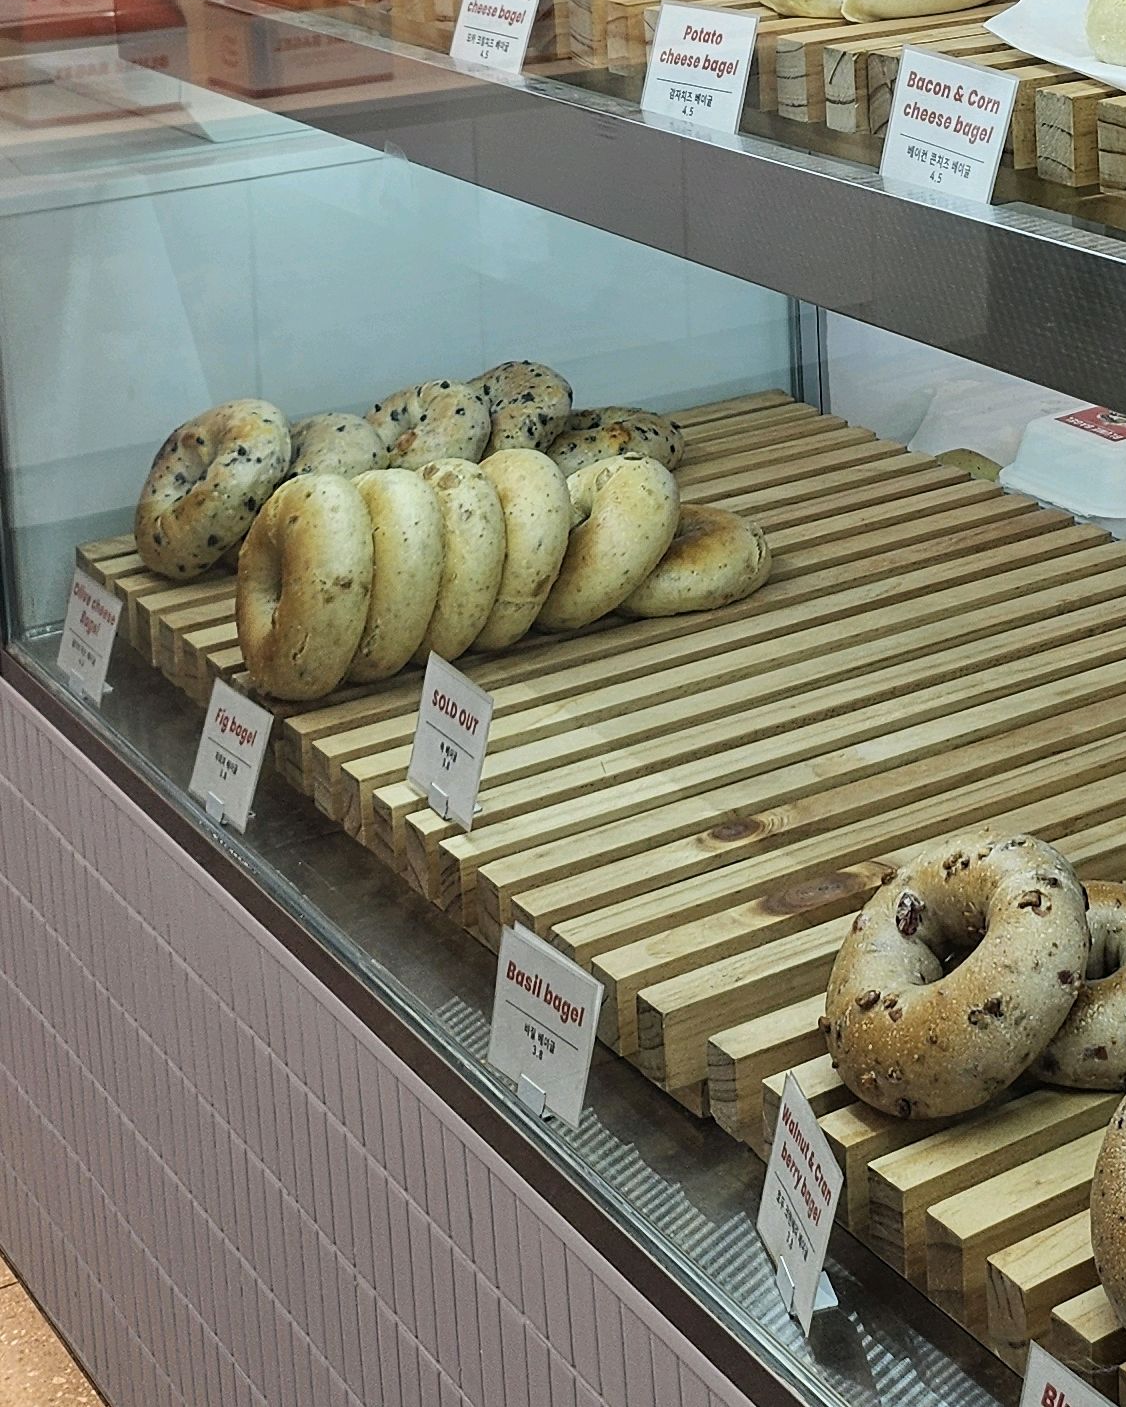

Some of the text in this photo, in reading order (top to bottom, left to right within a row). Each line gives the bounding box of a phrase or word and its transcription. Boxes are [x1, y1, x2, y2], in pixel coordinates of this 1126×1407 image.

[467, 0, 527, 26] cheese bagel
[683, 25, 723, 45] Potato
[660, 48, 739, 79] cheese bagel
[669, 88, 713, 107] 감자치즈 베이글
[907, 71, 1001, 115] Bacon & Corn
[682, 106, 694, 116] 4.5
[904, 101, 994, 144] cheese bagel
[907, 145, 971, 179] 베이컨 콘치즈 베이글
[930, 170, 943, 184] 4.5
[215, 707, 258, 747] Fig bagel
[432, 689, 479, 736] SOLD OUT
[506, 960, 585, 1027] Basil bagel
[524, 1023, 556, 1055] 바질 베이글
[532, 1045, 544, 1061] 3.8
[781, 1103, 832, 1207] Walnut & Cran
[780, 1141, 822, 1227] berry bagel
[1041, 1382, 1070, 1407] Bl
